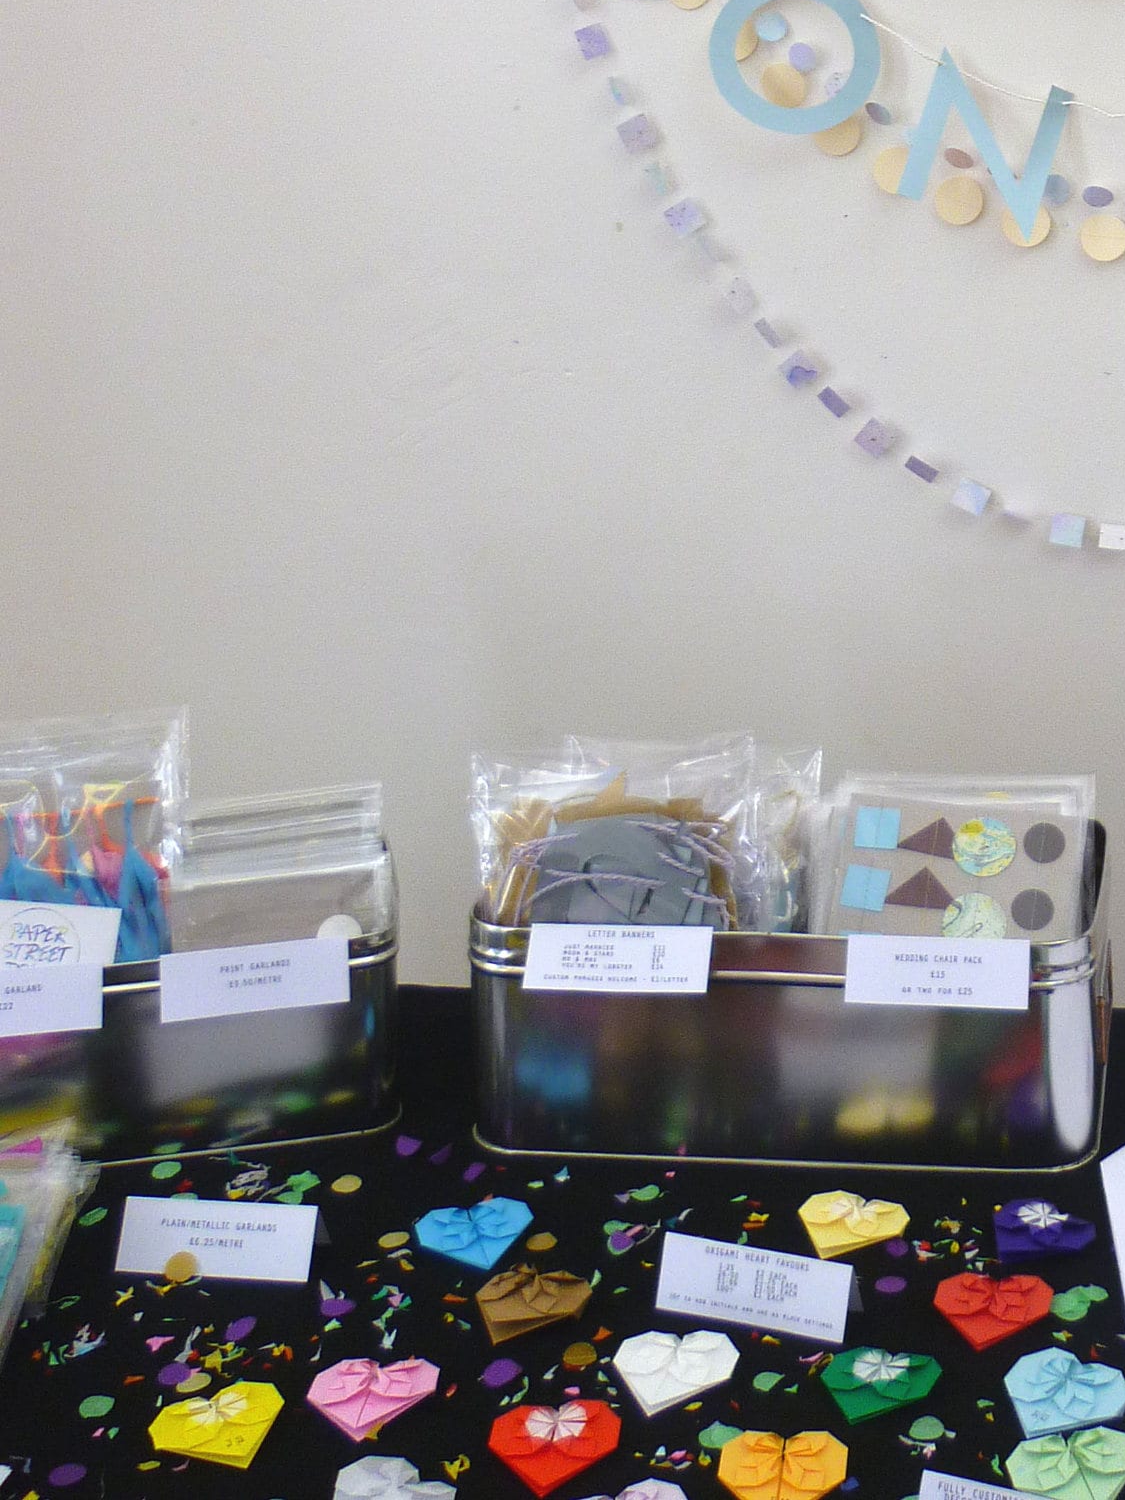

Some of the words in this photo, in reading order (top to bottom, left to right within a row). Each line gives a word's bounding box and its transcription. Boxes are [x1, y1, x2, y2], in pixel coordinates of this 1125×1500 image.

[11, 922, 69, 943] PAPER
[588, 930, 616, 938] LETTER
[2, 943, 74, 963] STREET
[895, 954, 928, 963] WEDDING
[934, 955, 958, 963] CHAIR
[963, 955, 983, 965] PACK
[220, 963, 244, 974] PRINT
[250, 959, 290, 970] GARLANDS
[930, 970, 946, 979] £15
[4, 983, 42, 995] GARLAND
[917, 986, 932, 994] TWO
[937, 986, 952, 995] FOR
[957, 987, 973, 996] £25
[161, 1218, 230, 1230] PLAIN/METALLIC
[236, 1221, 277, 1232] GARLANDS
[706, 1245, 739, 1259] ORIGAMI
[744, 1251, 770, 1265] HEART
[776, 1257, 810, 1272] FAVOURS
[938, 1481, 966, 1494] FULLY
